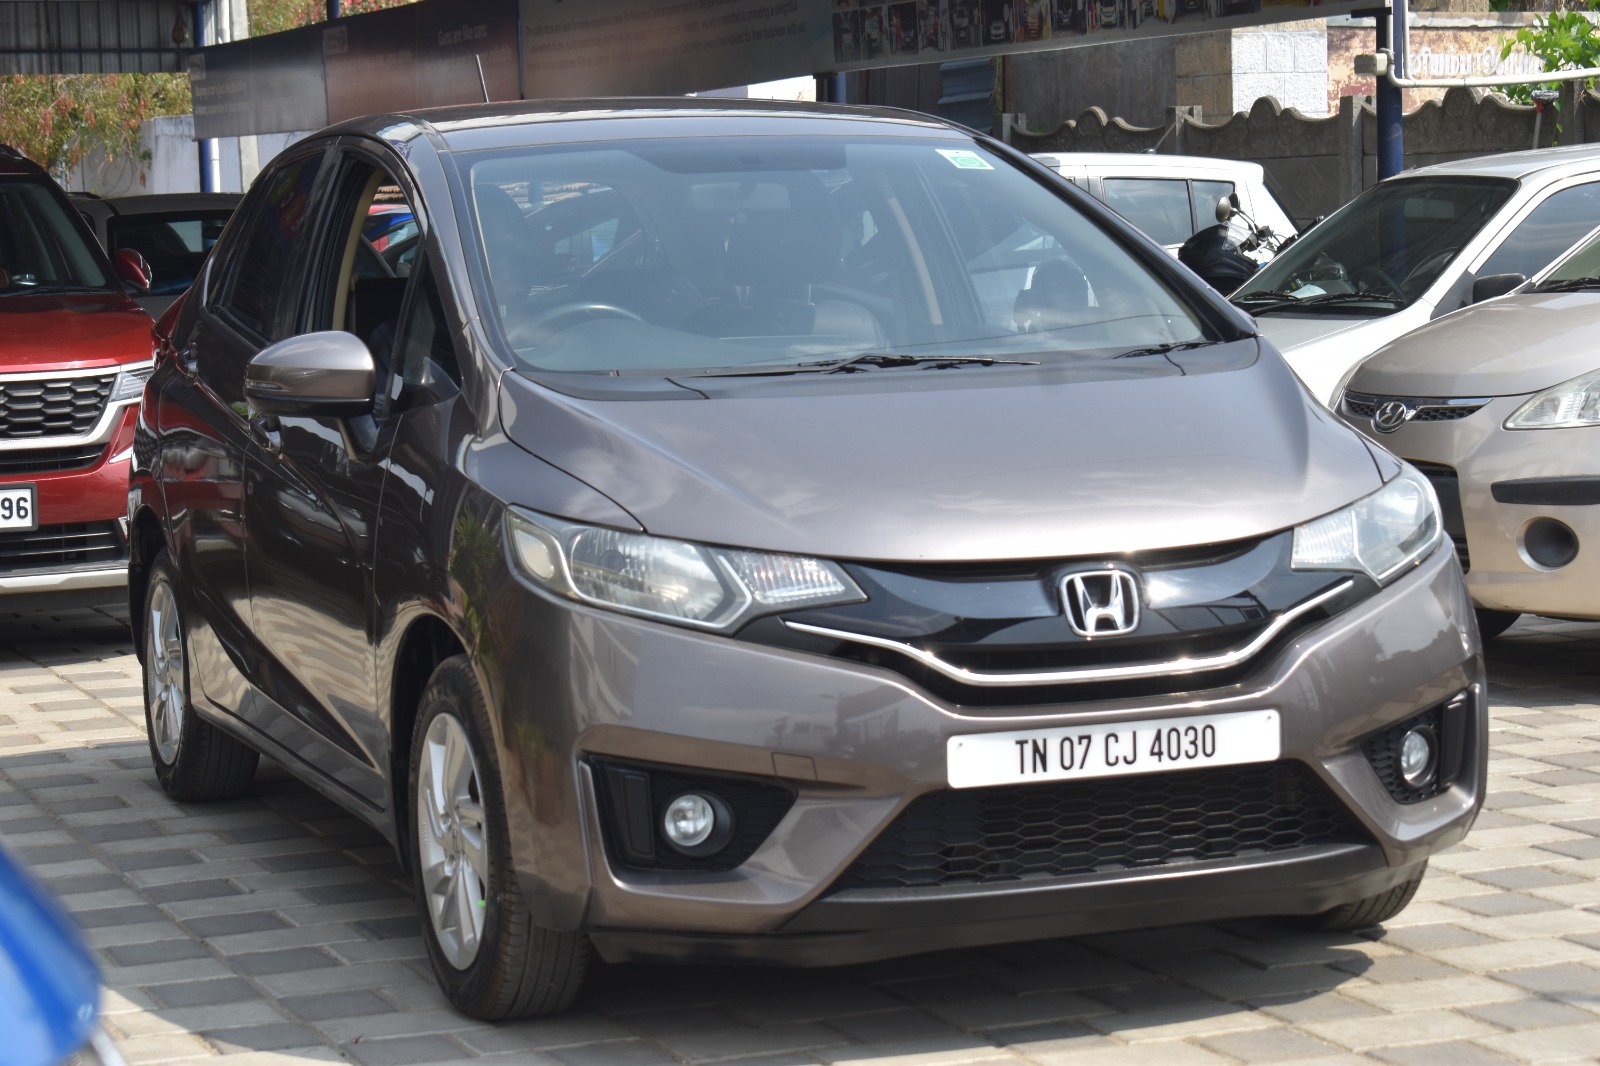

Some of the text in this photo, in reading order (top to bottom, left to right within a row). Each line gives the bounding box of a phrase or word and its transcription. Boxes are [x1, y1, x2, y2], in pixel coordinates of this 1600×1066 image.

[1, 497, 28, 520] 96
[1016, 724, 1215, 774] TN 07 CJ 4030
